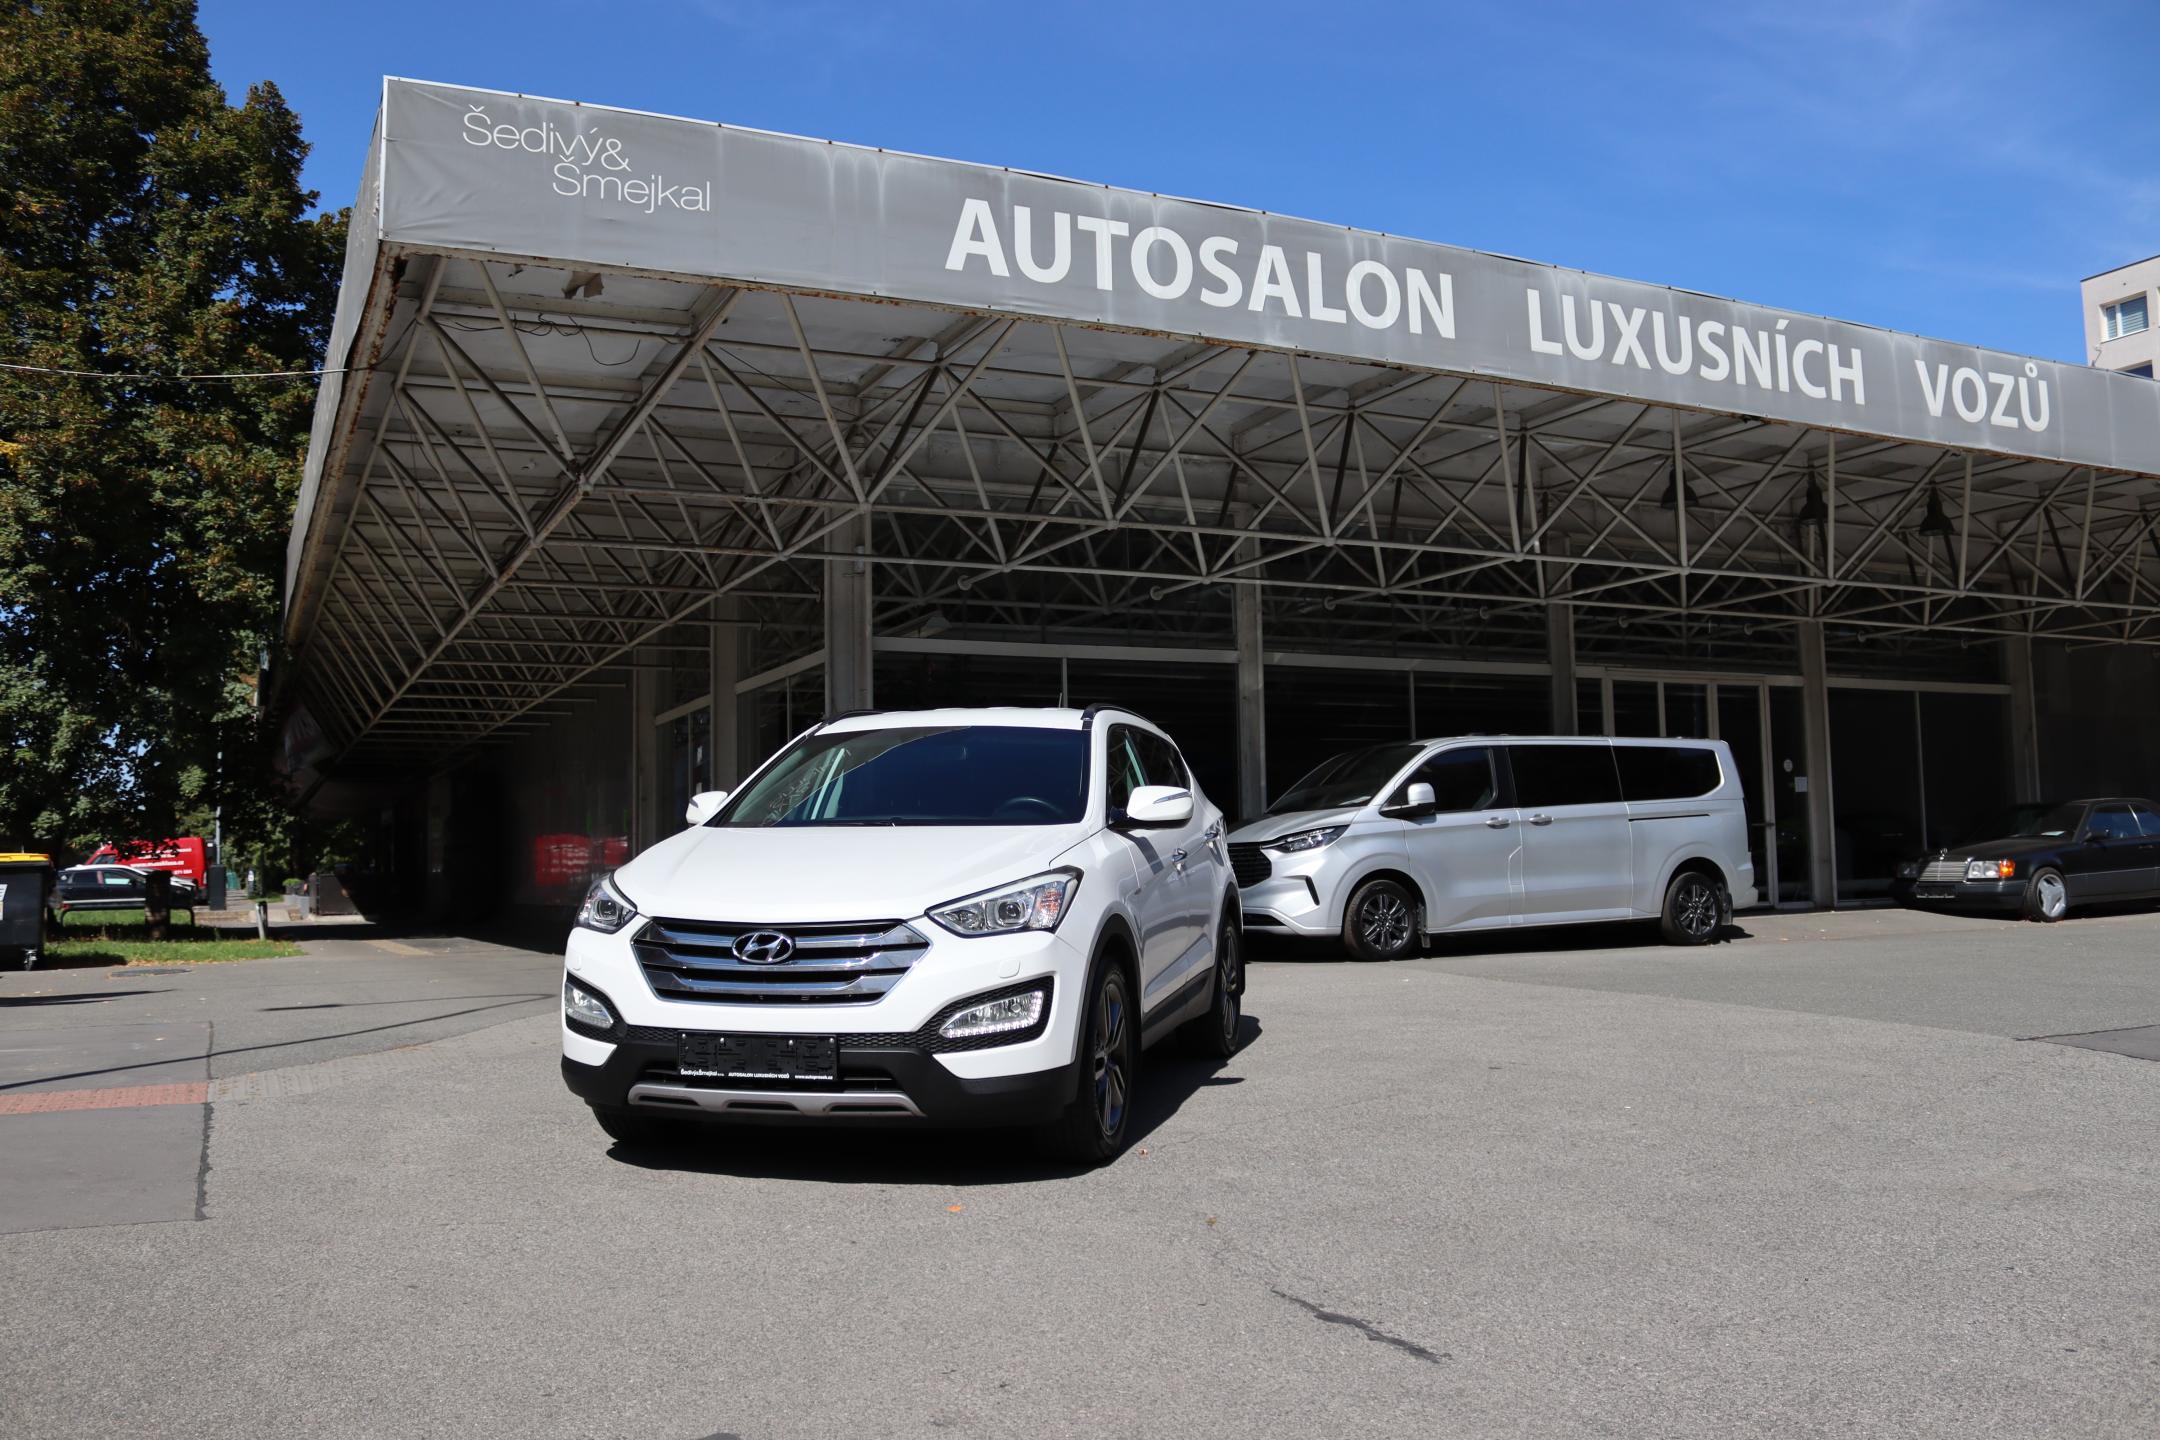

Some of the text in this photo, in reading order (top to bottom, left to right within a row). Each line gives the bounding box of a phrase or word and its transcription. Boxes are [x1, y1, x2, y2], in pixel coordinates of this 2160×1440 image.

[462, 104, 632, 173] Šedivý&
[552, 154, 711, 214] Šmejkal
[945, 198, 2050, 432] AUTOSALON LUXUSNÍCH VOZŮ
